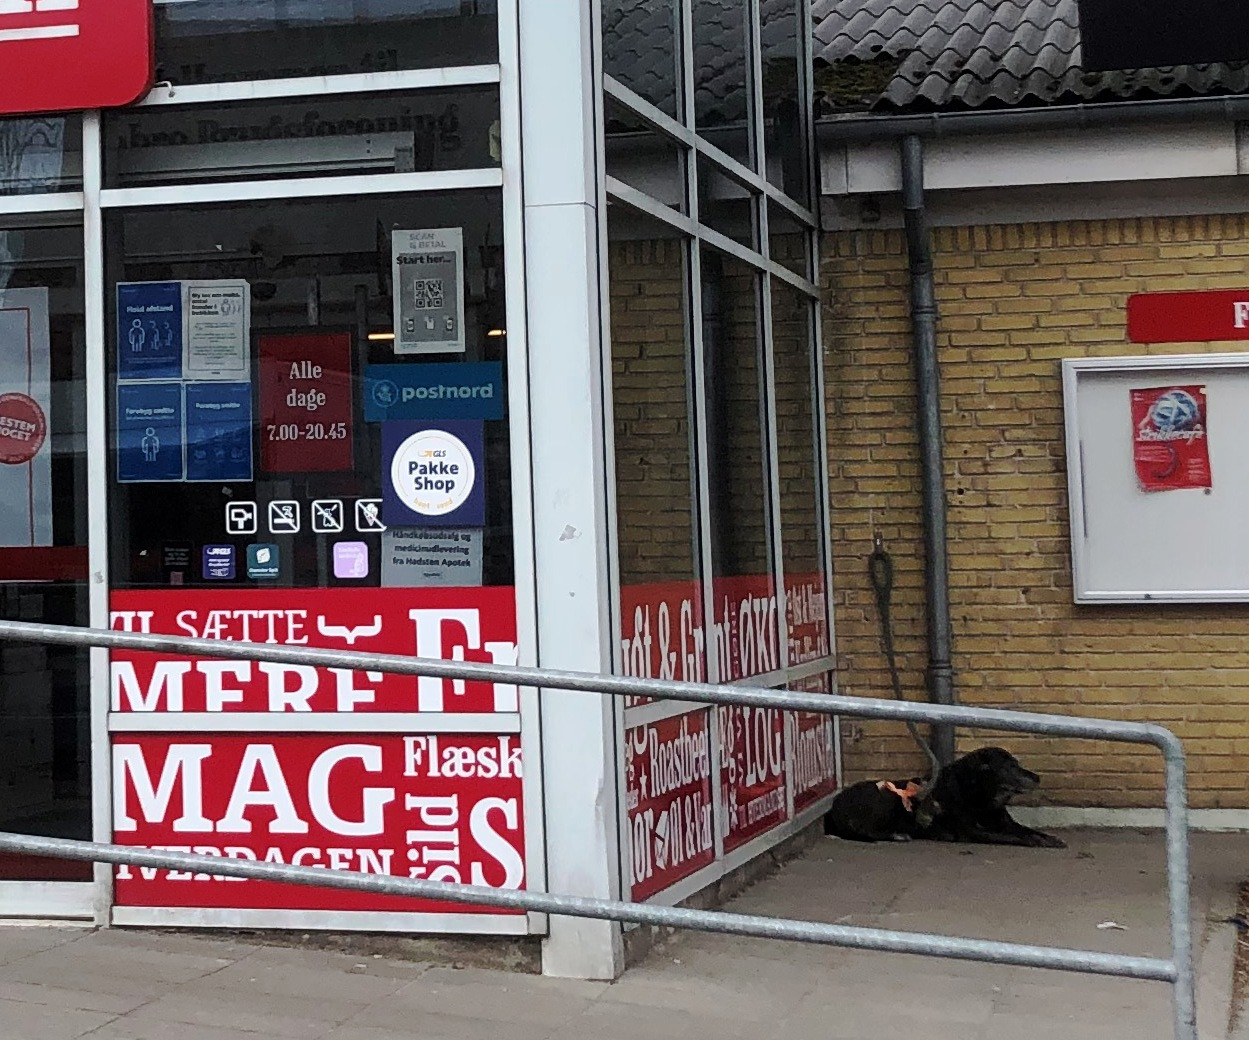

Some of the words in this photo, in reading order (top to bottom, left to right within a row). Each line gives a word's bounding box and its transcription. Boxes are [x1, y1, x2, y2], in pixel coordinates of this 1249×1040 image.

[396, 255, 425, 265] Start
[289, 360, 322, 379] Alle
[286, 388, 327, 411] dage
[402, 383, 494, 403] postnord
[266, 422, 347, 442] 7.00-20.45
[432, 450, 447, 458] GLS
[408, 461, 460, 475] Pakke
[414, 476, 456, 493] Shop
[392, 556, 404, 565] fra
[441, 558, 471, 568] Apotek
[175, 609, 309, 645] SÆTTE
[111, 659, 384, 712] MERE
[402, 735, 523, 779] Flæsk
[113, 743, 396, 837] MAG
